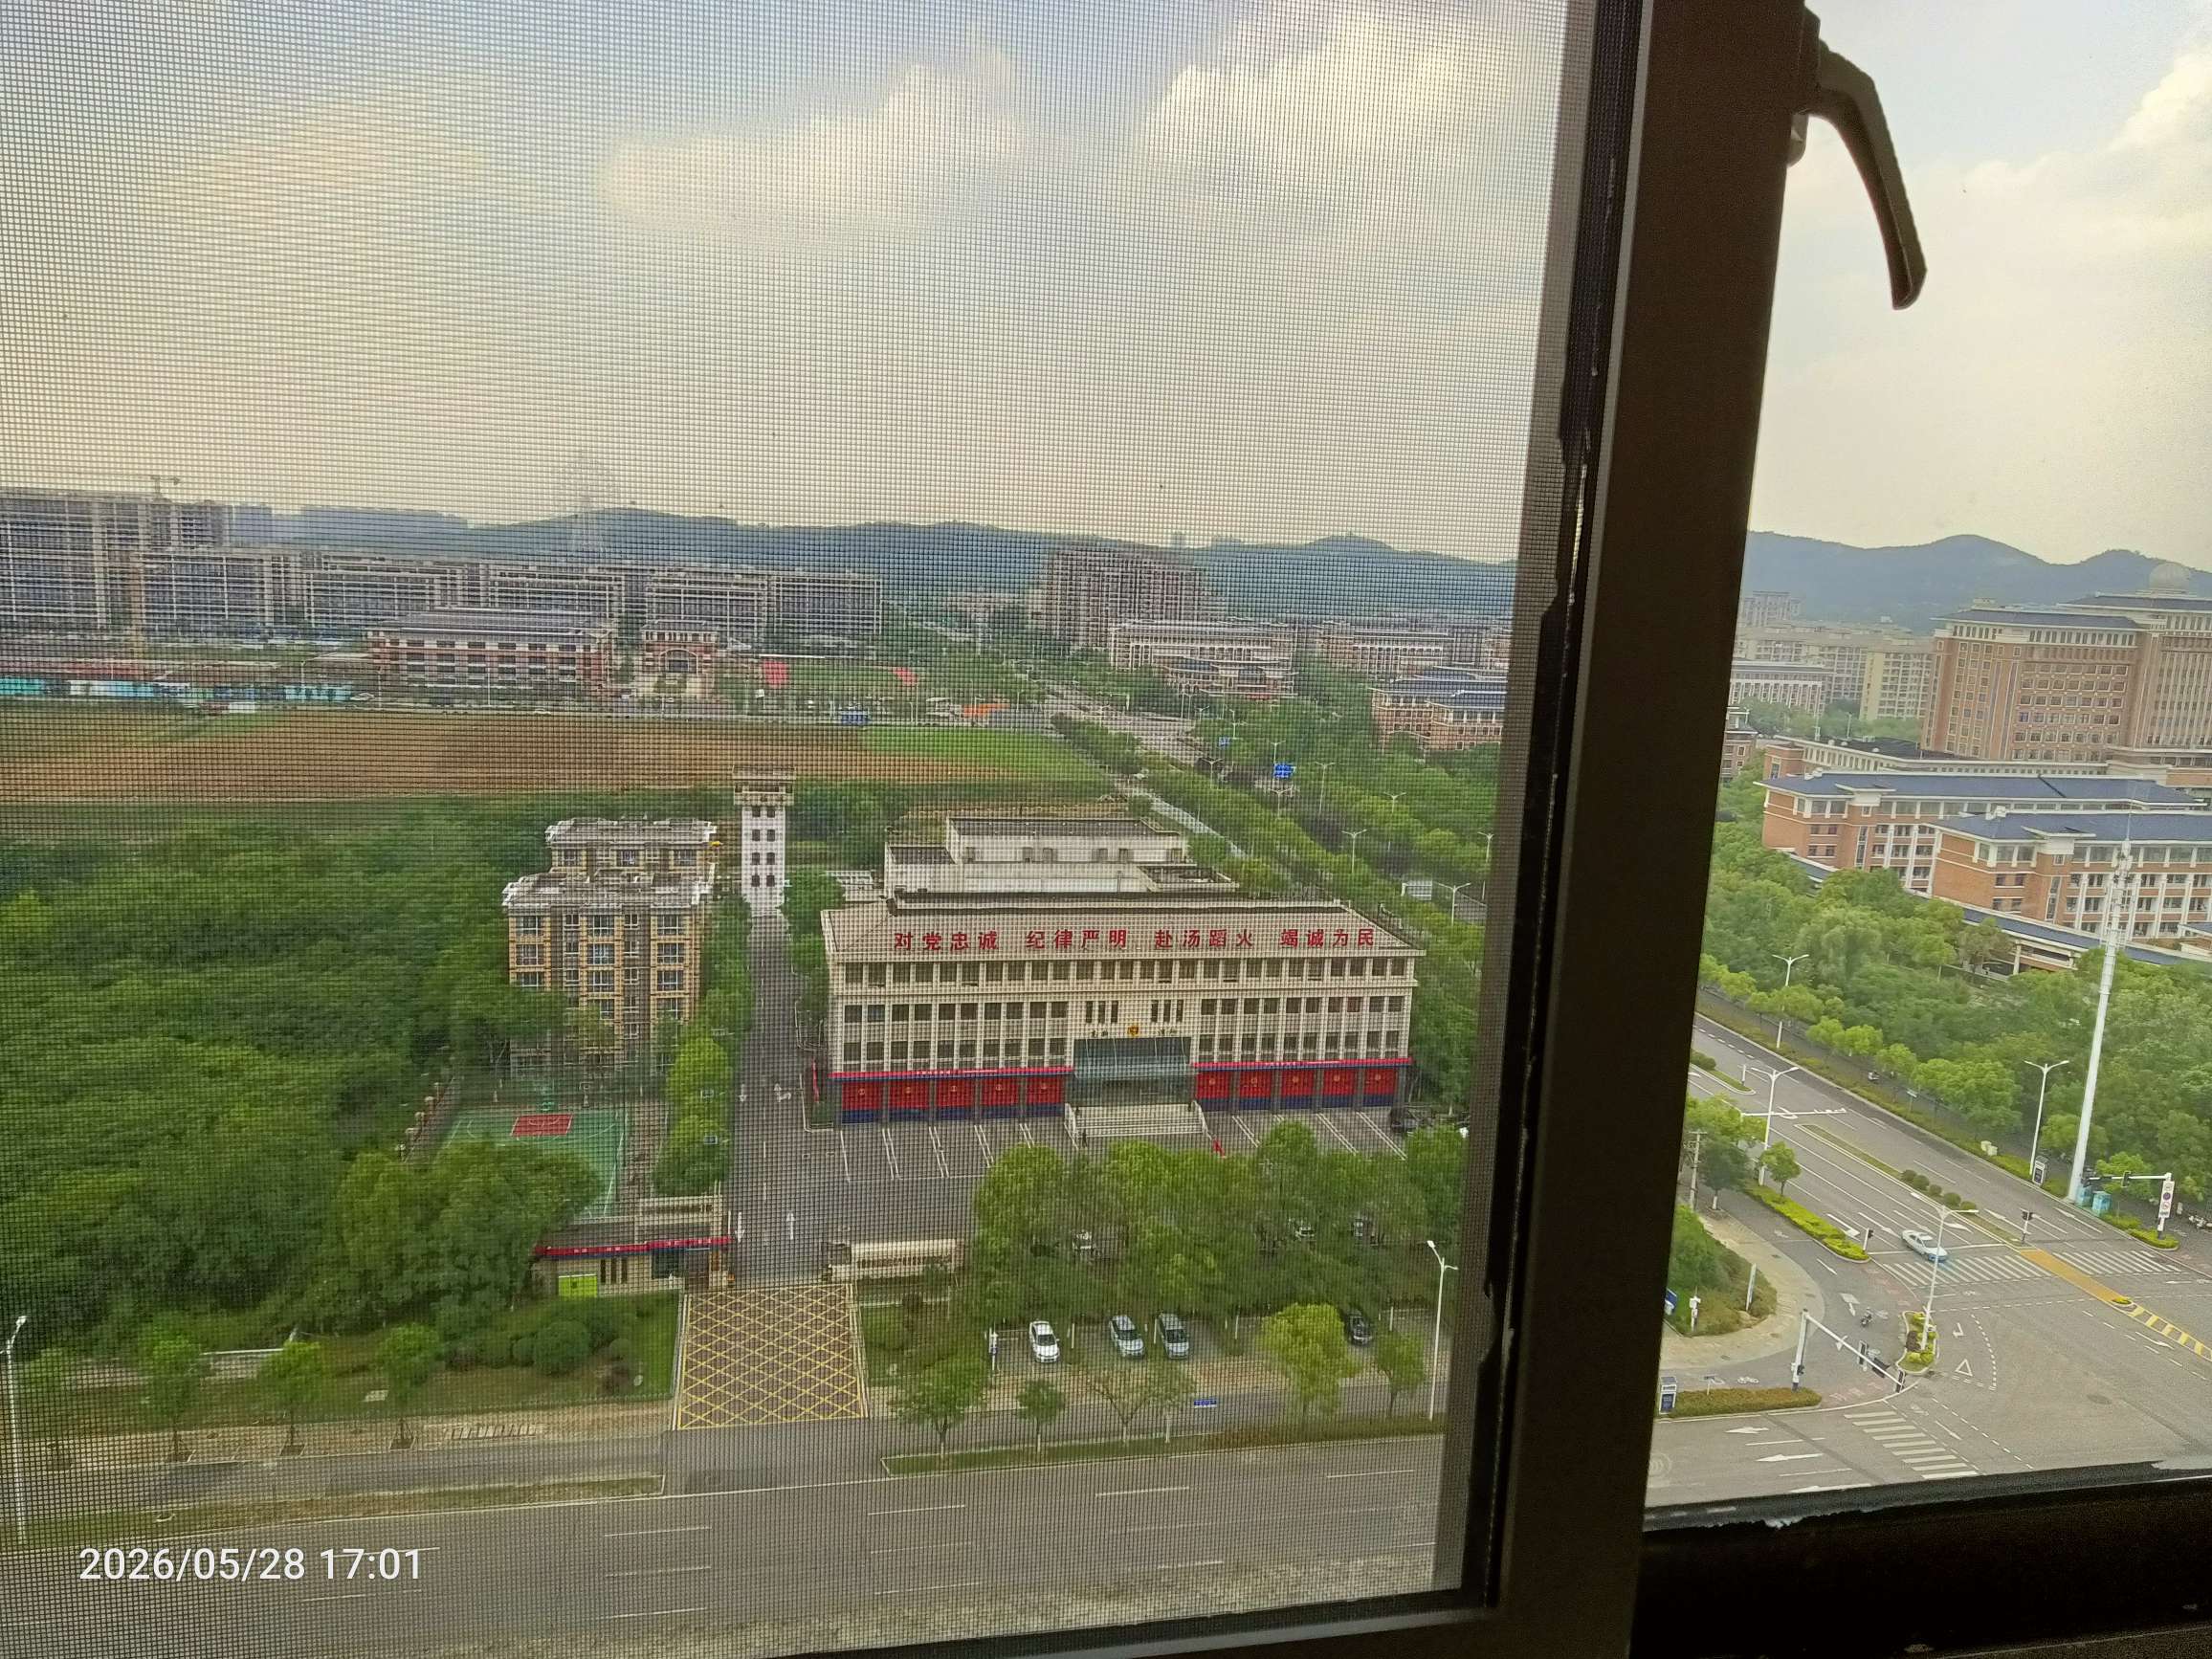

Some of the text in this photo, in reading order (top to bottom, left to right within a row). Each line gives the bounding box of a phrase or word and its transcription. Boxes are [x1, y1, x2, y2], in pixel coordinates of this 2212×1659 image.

[894, 928, 1375, 951] 对党忠诚 纪律严明 赴汤蹈火 竭诚为民
